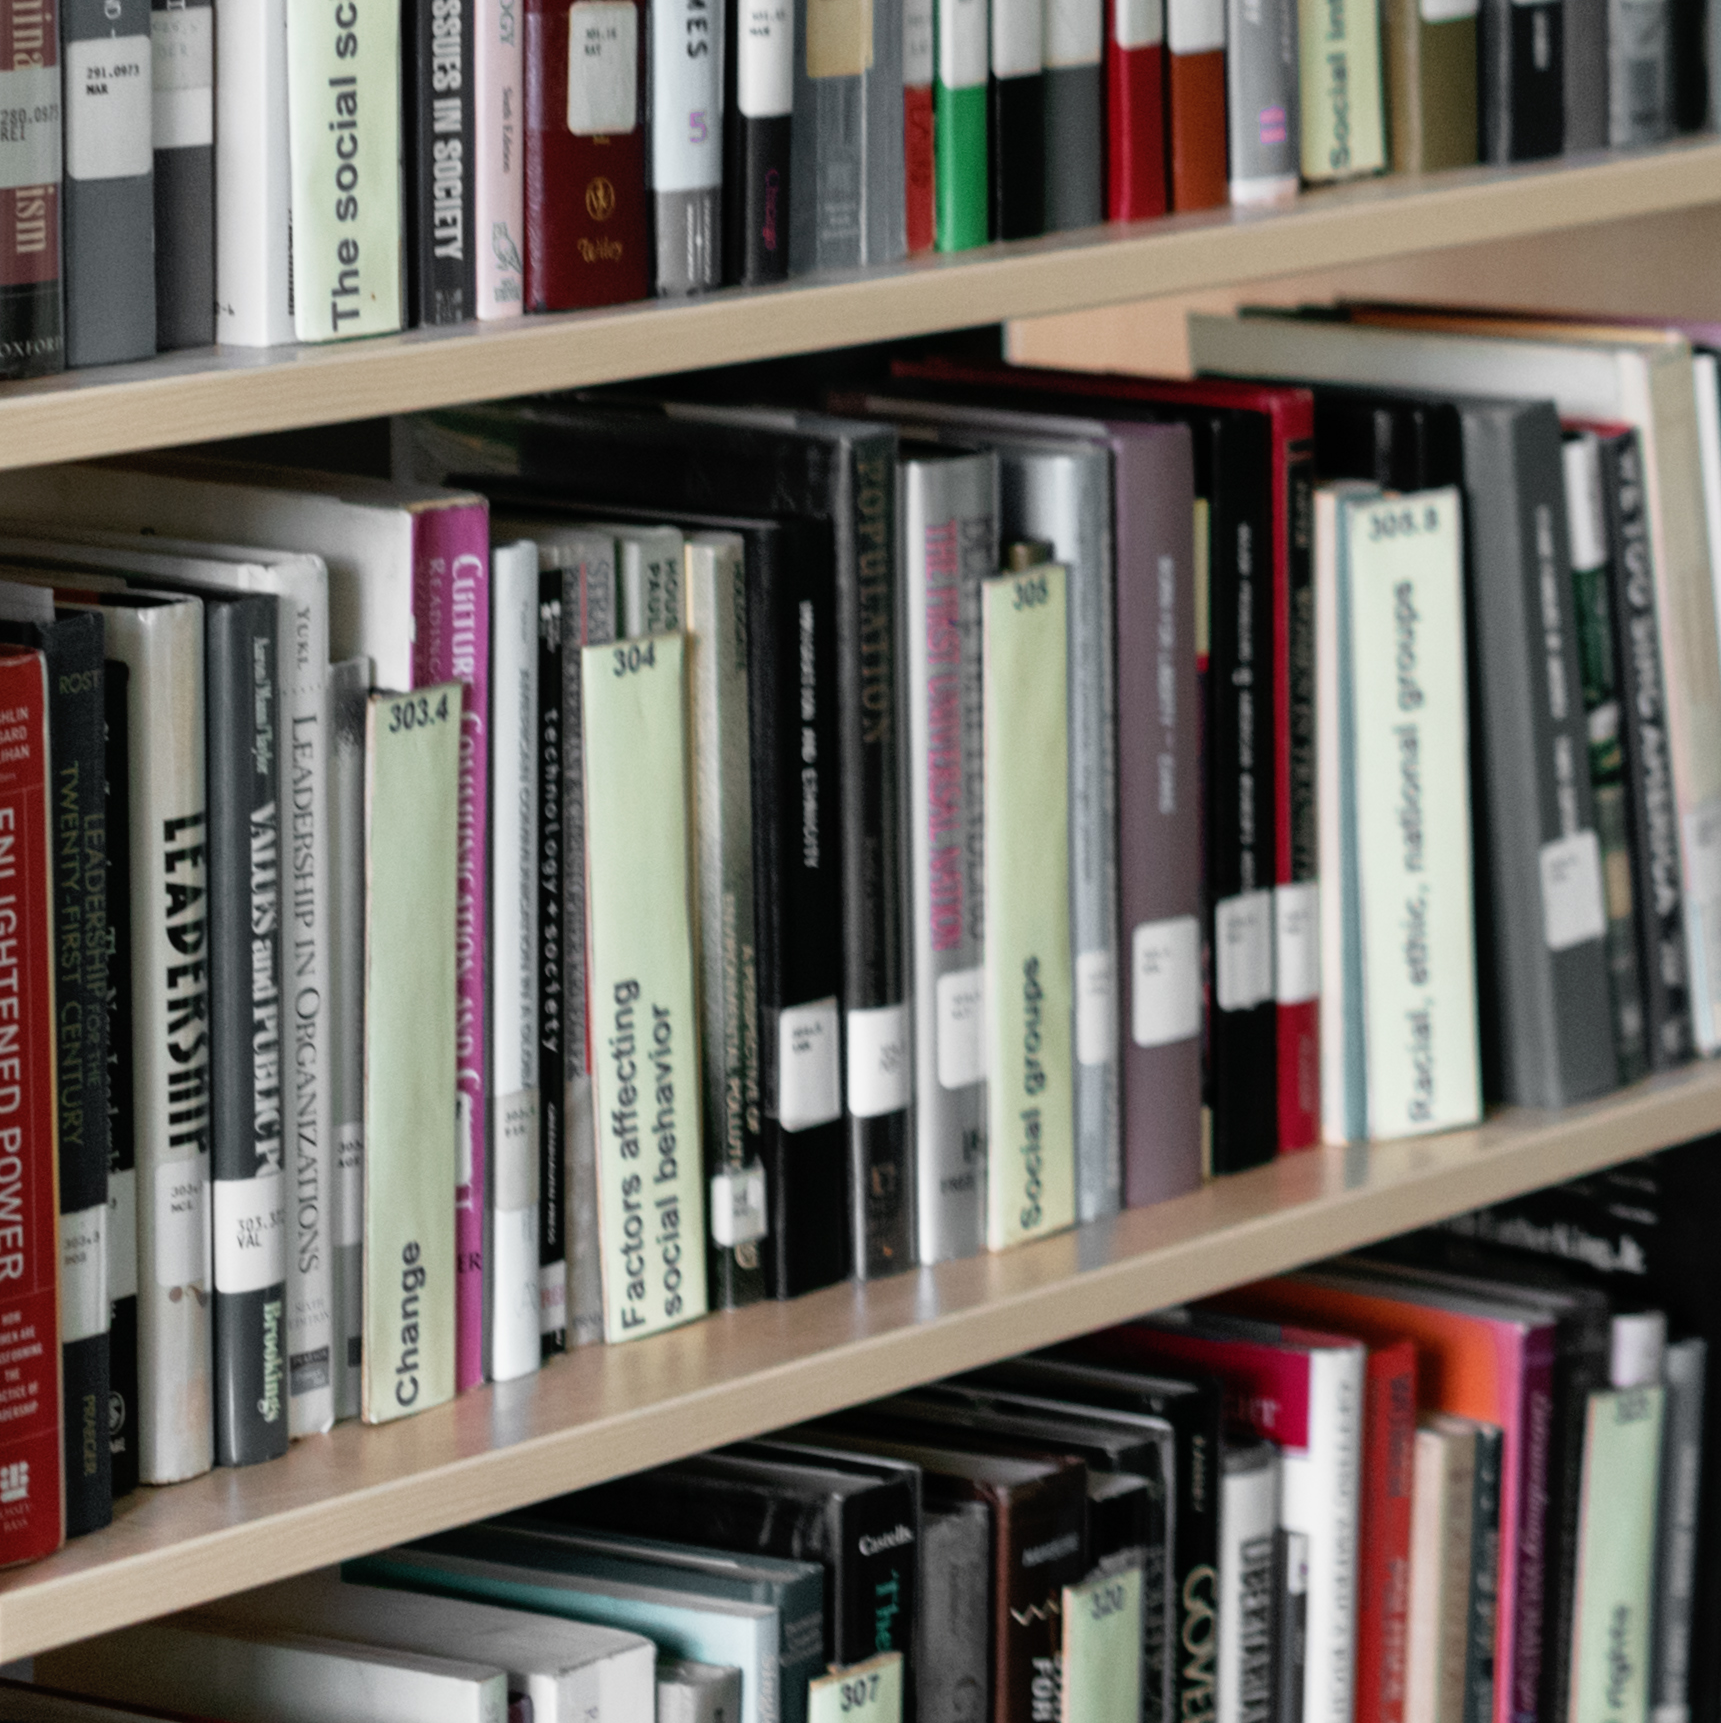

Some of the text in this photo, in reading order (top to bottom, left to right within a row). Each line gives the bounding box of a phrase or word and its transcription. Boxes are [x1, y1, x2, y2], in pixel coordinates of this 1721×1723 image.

[86, 83, 108, 96] MAR
[329, 75, 359, 221] social
[432, 98, 462, 131] IN
[1325, 52, 1351, 168] Social
[433, 140, 464, 259] SOCIETY
[330, 239, 360, 331] The
[1368, 506, 1439, 543] 305.8
[294, 607, 312, 669] YUKL
[1011, 575, 1049, 612] 305
[1392, 584, 1424, 714] groups
[388, 692, 449, 734] 303.4
[613, 640, 656, 678] 304
[1394, 725, 1424, 873] national
[81, 813, 105, 997] LEADERSHIP
[537, 708, 564, 1052] technology society
[57, 761, 84, 1147] TWENTY-FIRST CENTURY
[157, 814, 214, 1153] LEADERSHIP
[248, 802, 282, 1137] VALUES and PUBLIC
[289, 716, 323, 1274] LEADERSHIP IN ORGANIZATIONS
[85, 1003, 100, 1043] FOR
[1017, 956, 1046, 1228] Social groups
[0, 1125, 24, 1282] POWER
[611, 979, 646, 1329] Factors affecting
[647, 1002, 682, 1318] social behavior
[237, 1230, 262, 1251] VAL
[253, 1300, 286, 1423] Brookings
[389, 1240, 430, 1407] Change
[875, 1568, 898, 1650] The
[840, 1673, 881, 1714] 307
